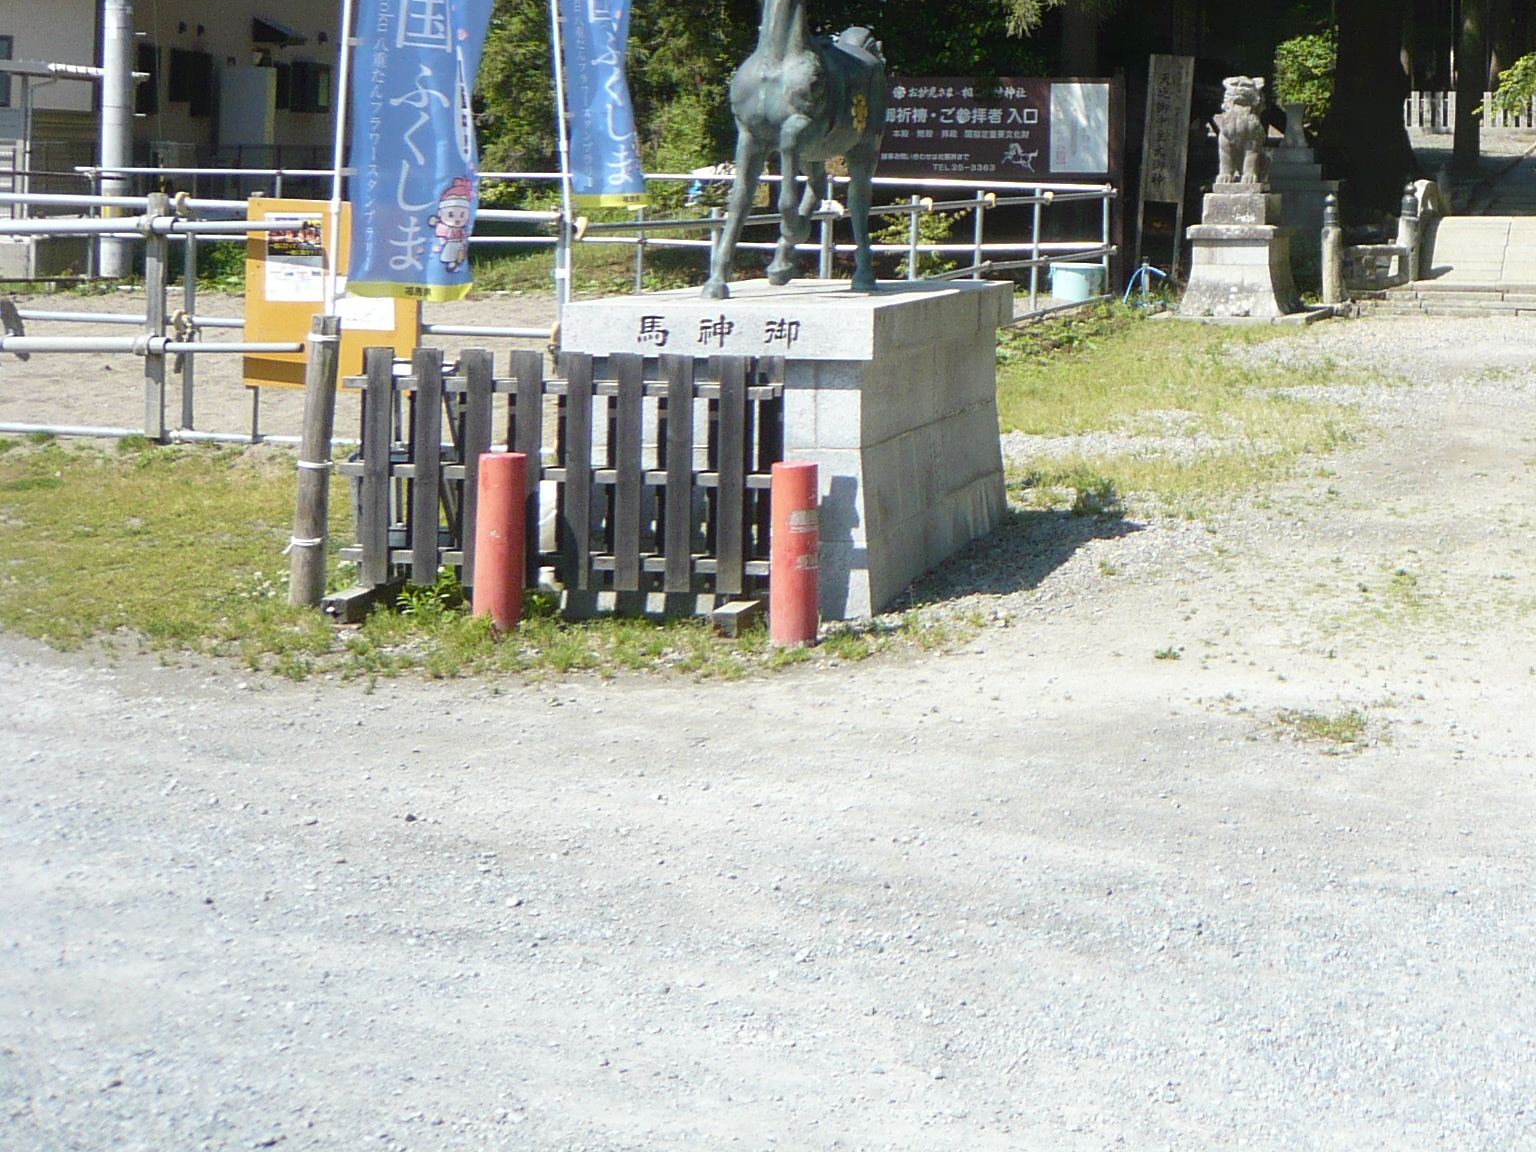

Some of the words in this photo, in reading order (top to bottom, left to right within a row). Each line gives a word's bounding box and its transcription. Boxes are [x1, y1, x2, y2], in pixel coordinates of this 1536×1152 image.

[591, 22, 634, 187] ふくしま
[1007, 107, 1039, 124] 入口
[388, 65, 450, 272] ふくしま
[932, 163, 950, 173] TEL
